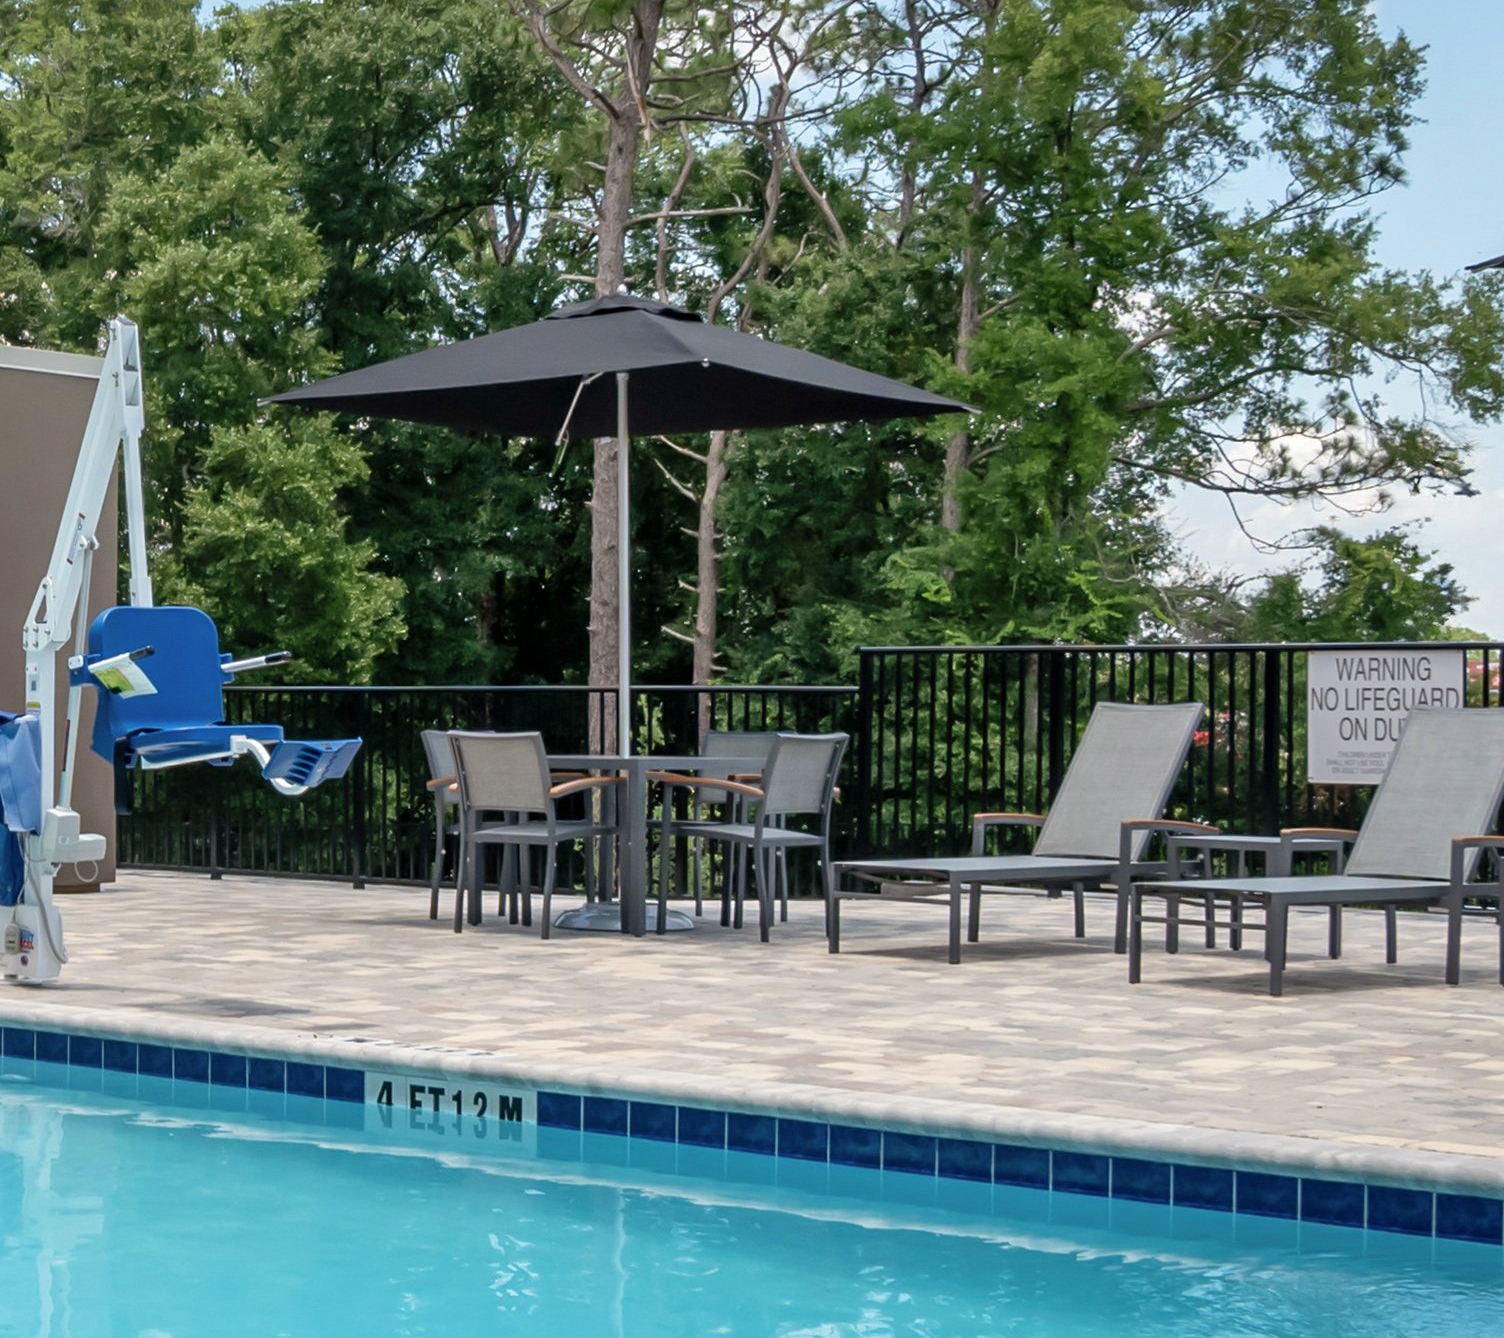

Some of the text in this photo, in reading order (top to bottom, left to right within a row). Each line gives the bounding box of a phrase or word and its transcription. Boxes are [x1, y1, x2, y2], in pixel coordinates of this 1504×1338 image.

[1336, 657, 1432, 681] WARNING
[1311, 687, 1460, 711] NO LIFEGUARD
[1339, 717, 1406, 742] ON DU
